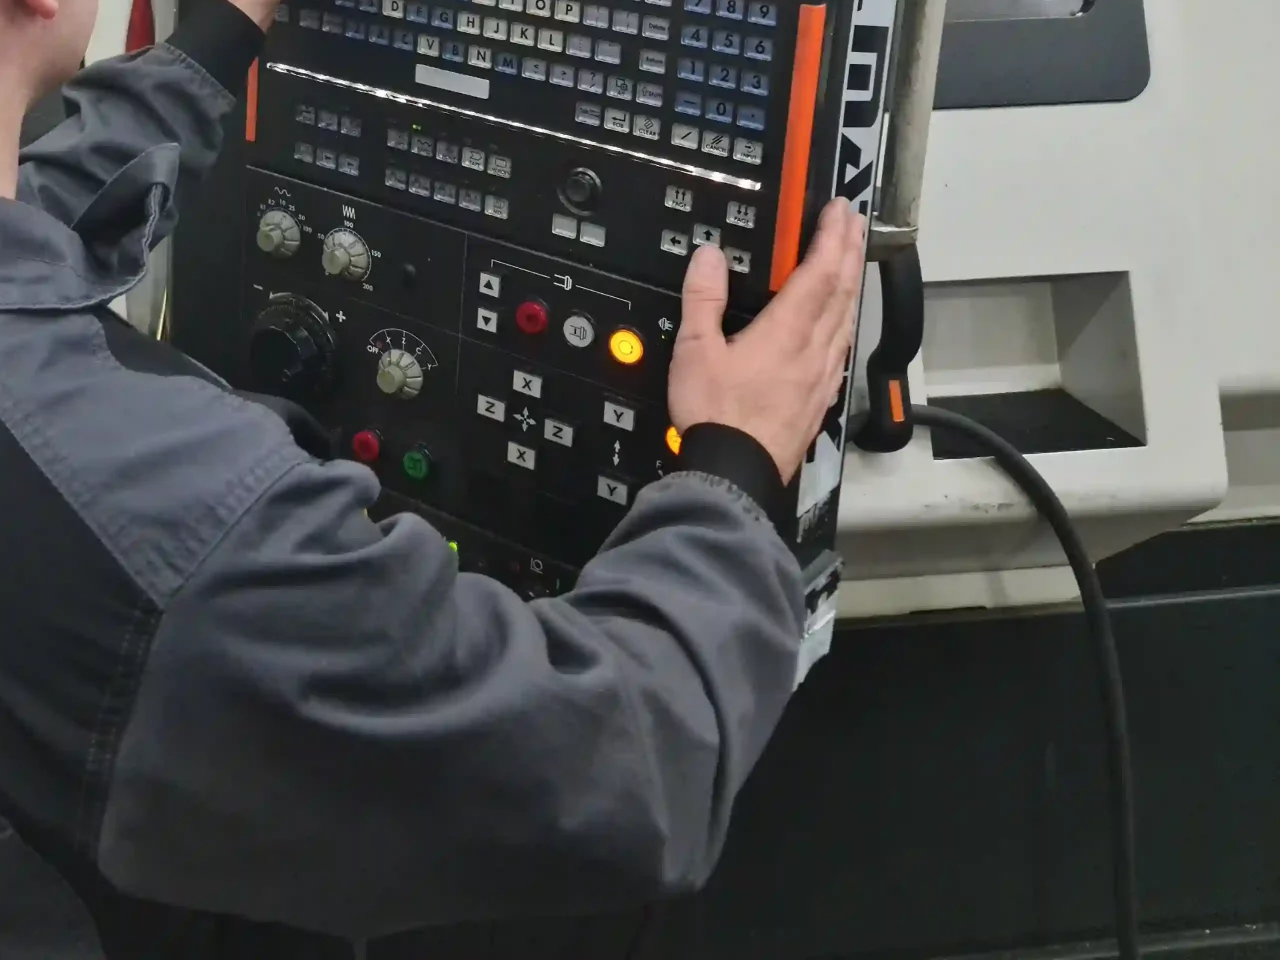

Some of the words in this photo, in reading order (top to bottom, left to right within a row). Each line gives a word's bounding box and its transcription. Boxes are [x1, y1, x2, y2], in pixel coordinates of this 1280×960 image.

[565, 3, 573, 16] P
[726, 0, 736, 14] 8
[759, 4, 769, 19] 9
[391, 0, 399, 12] D
[440, 11, 448, 23] G
[467, 17, 475, 29] H
[493, 22, 500, 34] J
[520, 27, 528, 40] K
[549, 33, 555, 46] L
[691, 29, 701, 42] 4
[724, 33, 734, 48] 5
[755, 40, 765, 54] 6
[426, 39, 435, 50] V
[477, 50, 486, 62] N
[502, 56, 513, 69] M
[689, 61, 695, 75] 1
[720, 68, 730, 82] 2
[752, 74, 761, 89] 3
[716, 102, 726, 116] 0
[638, 127, 657, 137] CLEAR
[740, 152, 757, 161] INPUT
[672, 200, 687, 208] PAGE
[734, 216, 749, 224] PAGE
[371, 249, 382, 258] 150
[362, 283, 373, 291] 200
[367, 345, 379, 354] OFF
[521, 377, 532, 391] X
[485, 401, 496, 414] Z
[613, 409, 624, 423] Y
[552, 425, 564, 439] Z
[516, 449, 526, 462] X
[606, 483, 617, 496] Y
